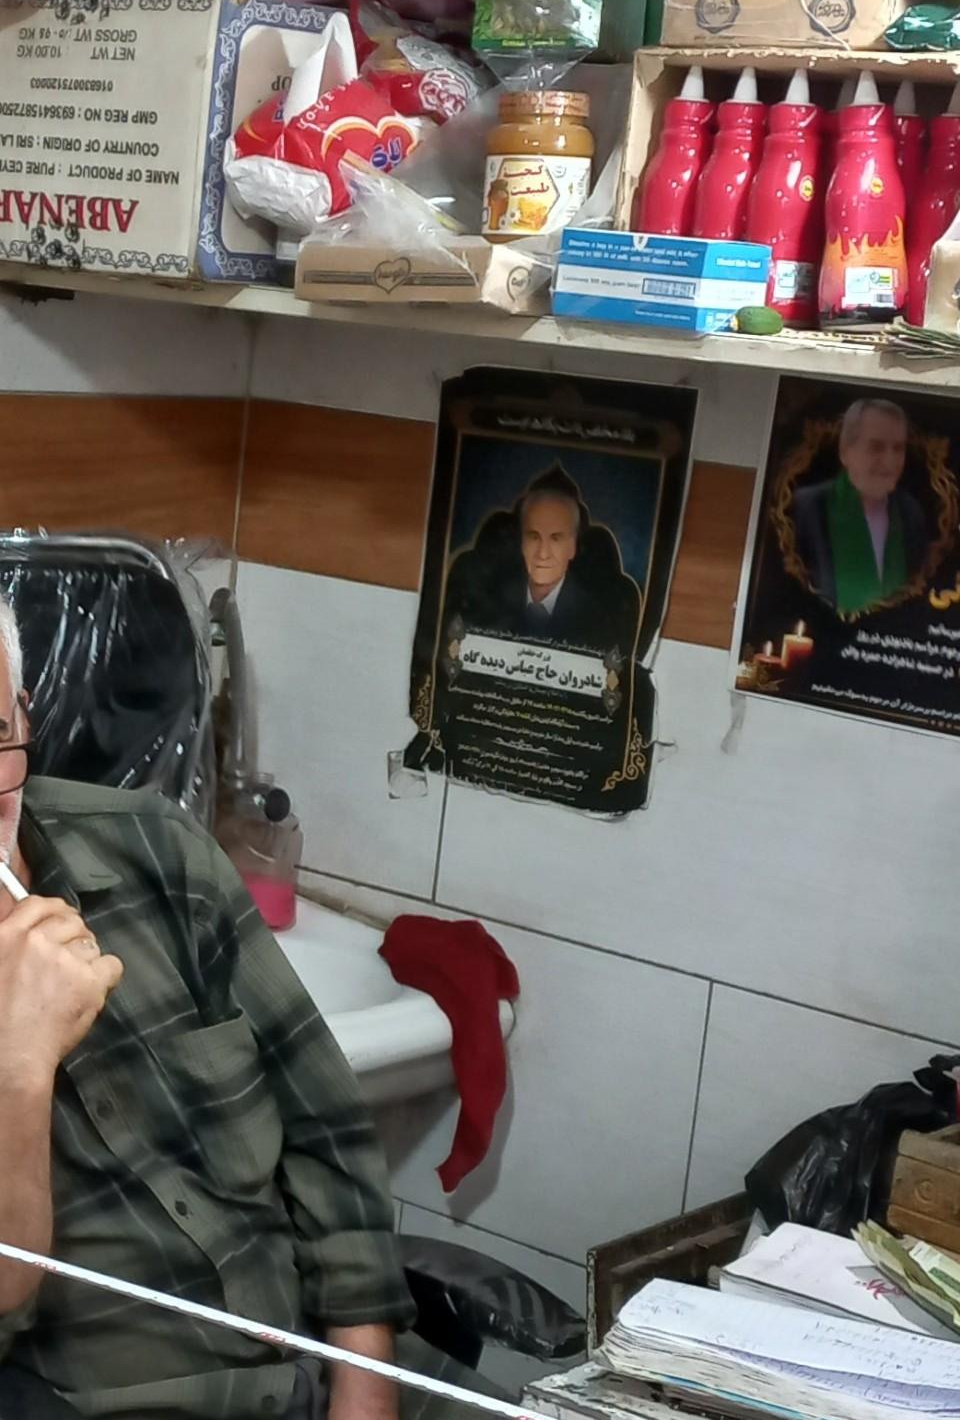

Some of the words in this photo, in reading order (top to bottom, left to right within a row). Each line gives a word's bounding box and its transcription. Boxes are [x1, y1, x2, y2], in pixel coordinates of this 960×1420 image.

[95, 28, 137, 44] GROSS
[16, 44, 33, 57] KG
[90, 46, 109, 60] WT
[110, 47, 135, 60] NET
[84, 107, 102, 122] NO
[103, 109, 129, 124] REG
[131, 111, 158, 126] GMP
[16, 134, 34, 148] SRI
[43, 136, 82, 153] ORIGIN
[85, 139, 101, 154] OF
[104, 141, 159, 157] COUNTRY
[26, 161, 55, 176] PURE
[68, 163, 123, 181] PRODUCT
[126, 169, 143, 182] OF
[145, 169, 180, 185] NAME
[480, 655, 505, 672] دیده
[505, 658, 536, 677] عباس
[535, 664, 557, 681] حاج
[558, 670, 603, 691] شادروان
